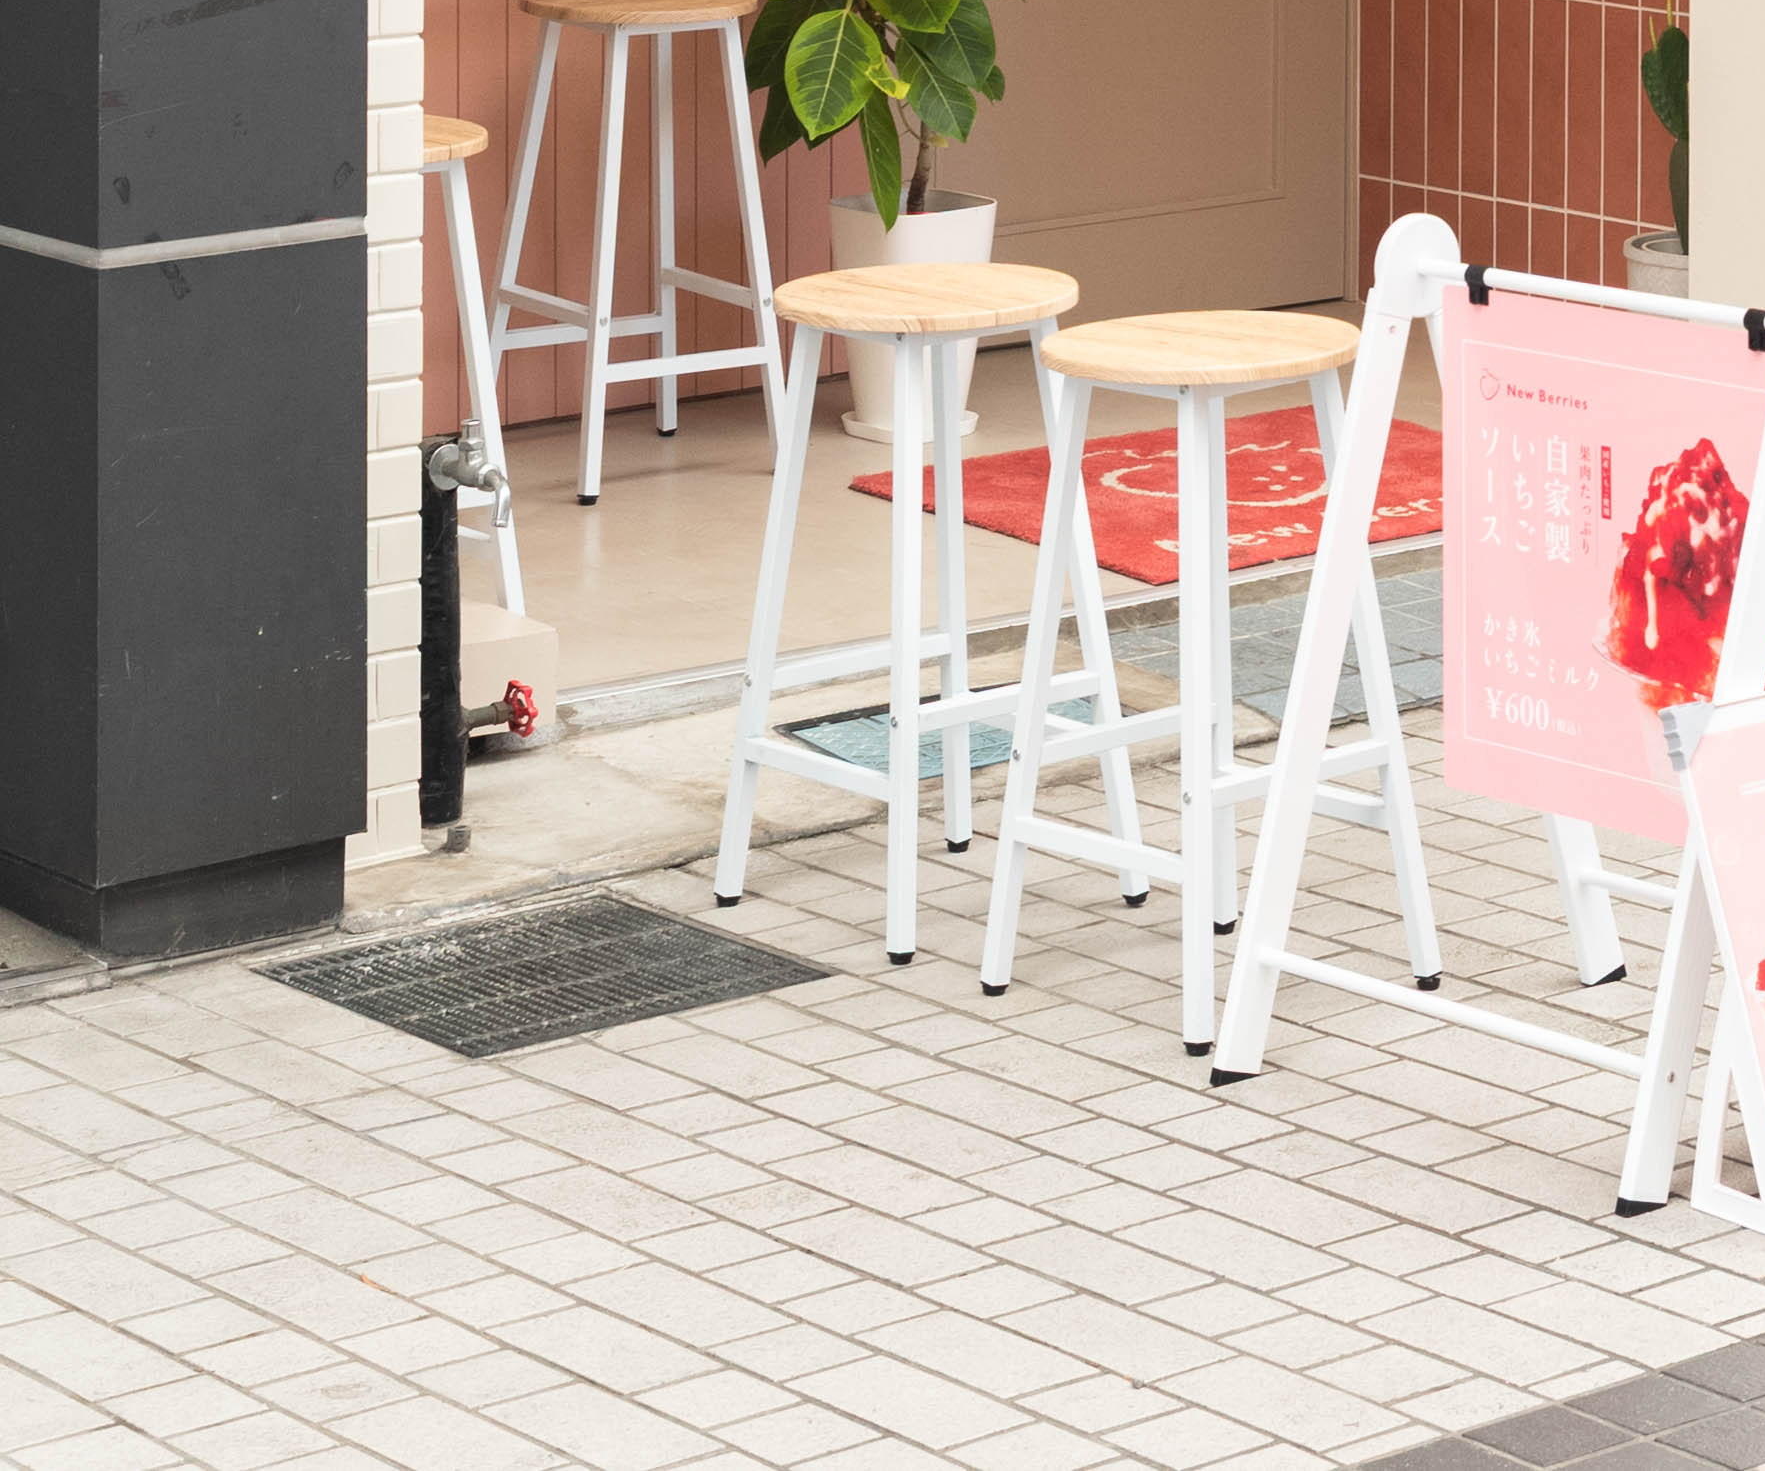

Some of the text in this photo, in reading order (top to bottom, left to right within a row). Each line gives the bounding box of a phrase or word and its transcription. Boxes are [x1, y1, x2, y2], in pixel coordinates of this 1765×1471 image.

[1507, 384, 1589, 410] New Berries
[1480, 426, 1502, 546] ソース
[1512, 434, 1537, 553] いちご
[1544, 435, 1572, 563] 自家製
[1579, 444, 1593, 556] 果肉たっぷり
[1483, 613, 1541, 648] かき氷
[1483, 646, 1600, 692] いちごミルク
[1483, 686, 1550, 731] ¥600
